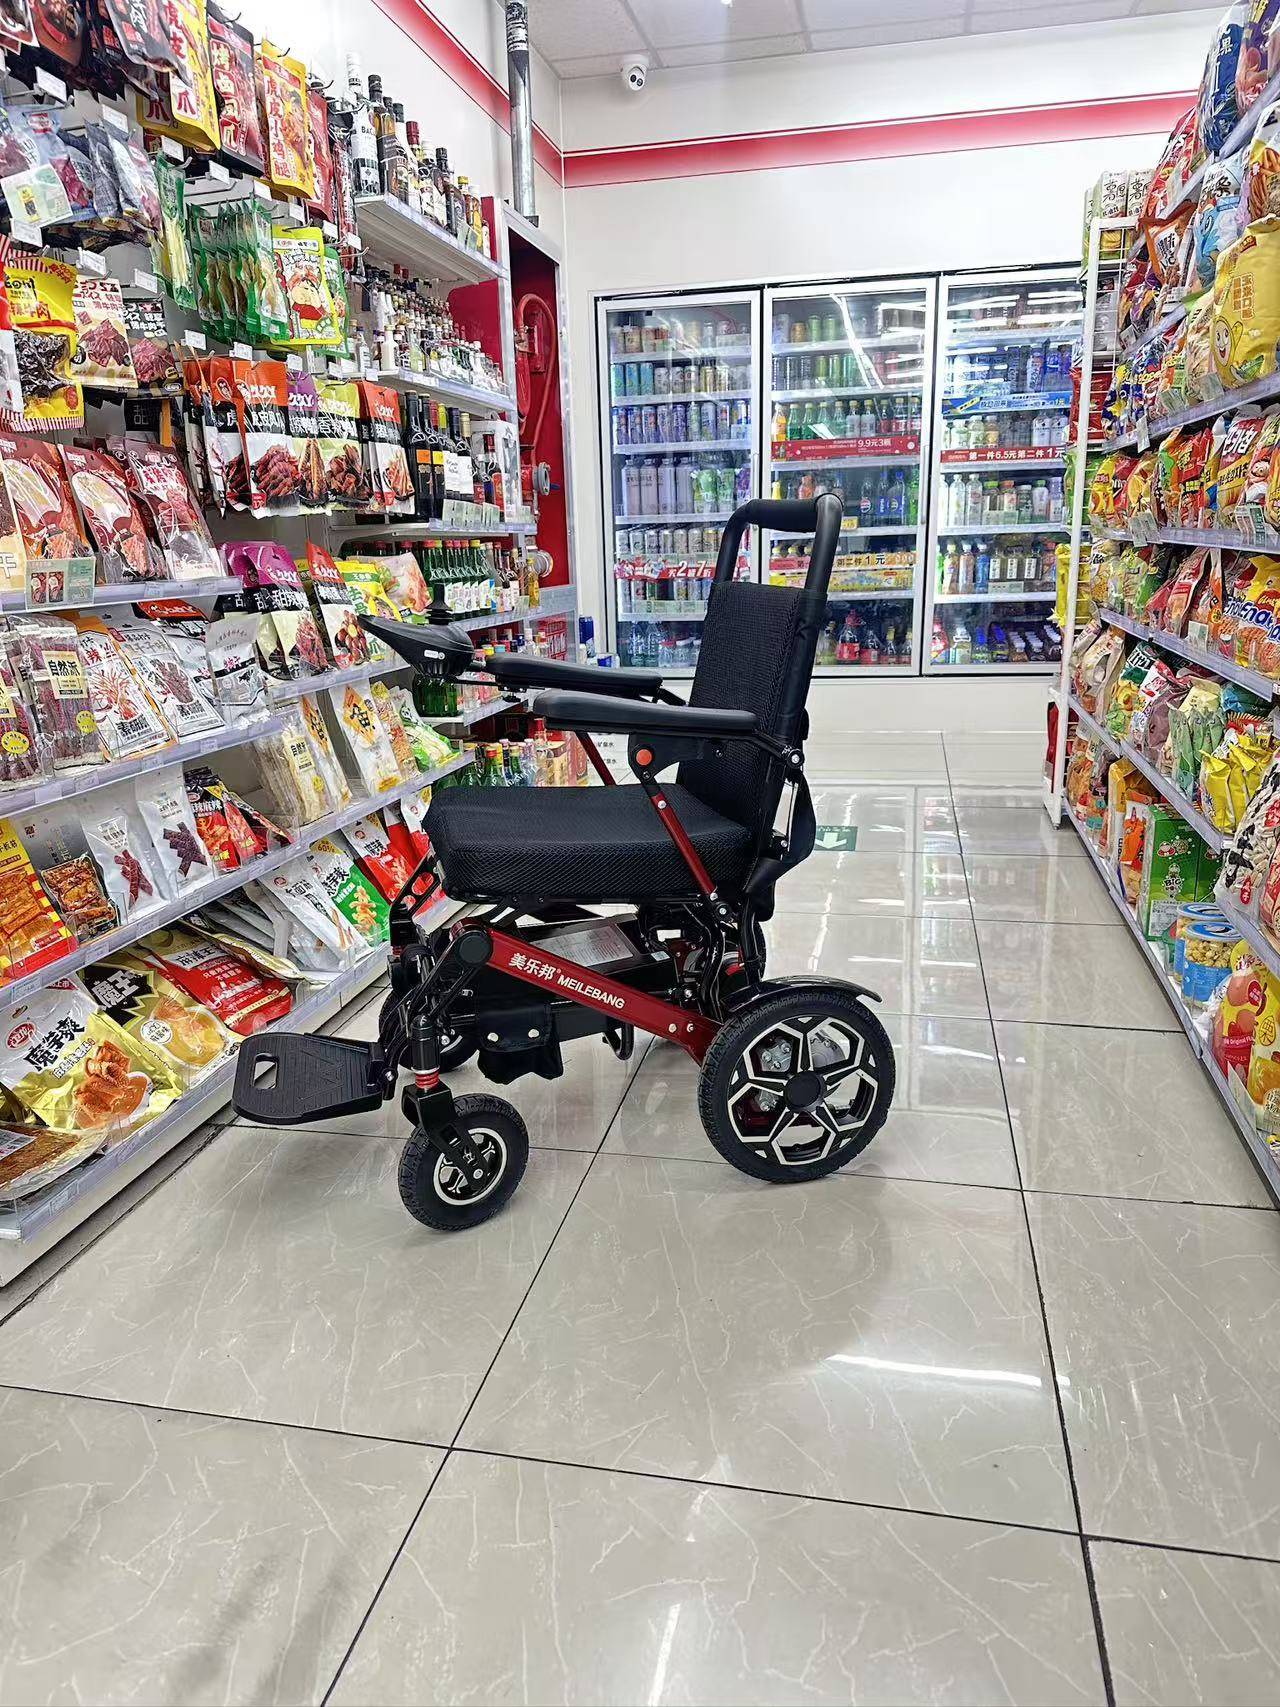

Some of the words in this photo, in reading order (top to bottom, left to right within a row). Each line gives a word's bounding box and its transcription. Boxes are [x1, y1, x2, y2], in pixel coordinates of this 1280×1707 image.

[163, 0, 197, 118] 虎皮爪
[508, 952, 557, 981] 美乐邦
[557, 974, 625, 1010] MEILEBANG
